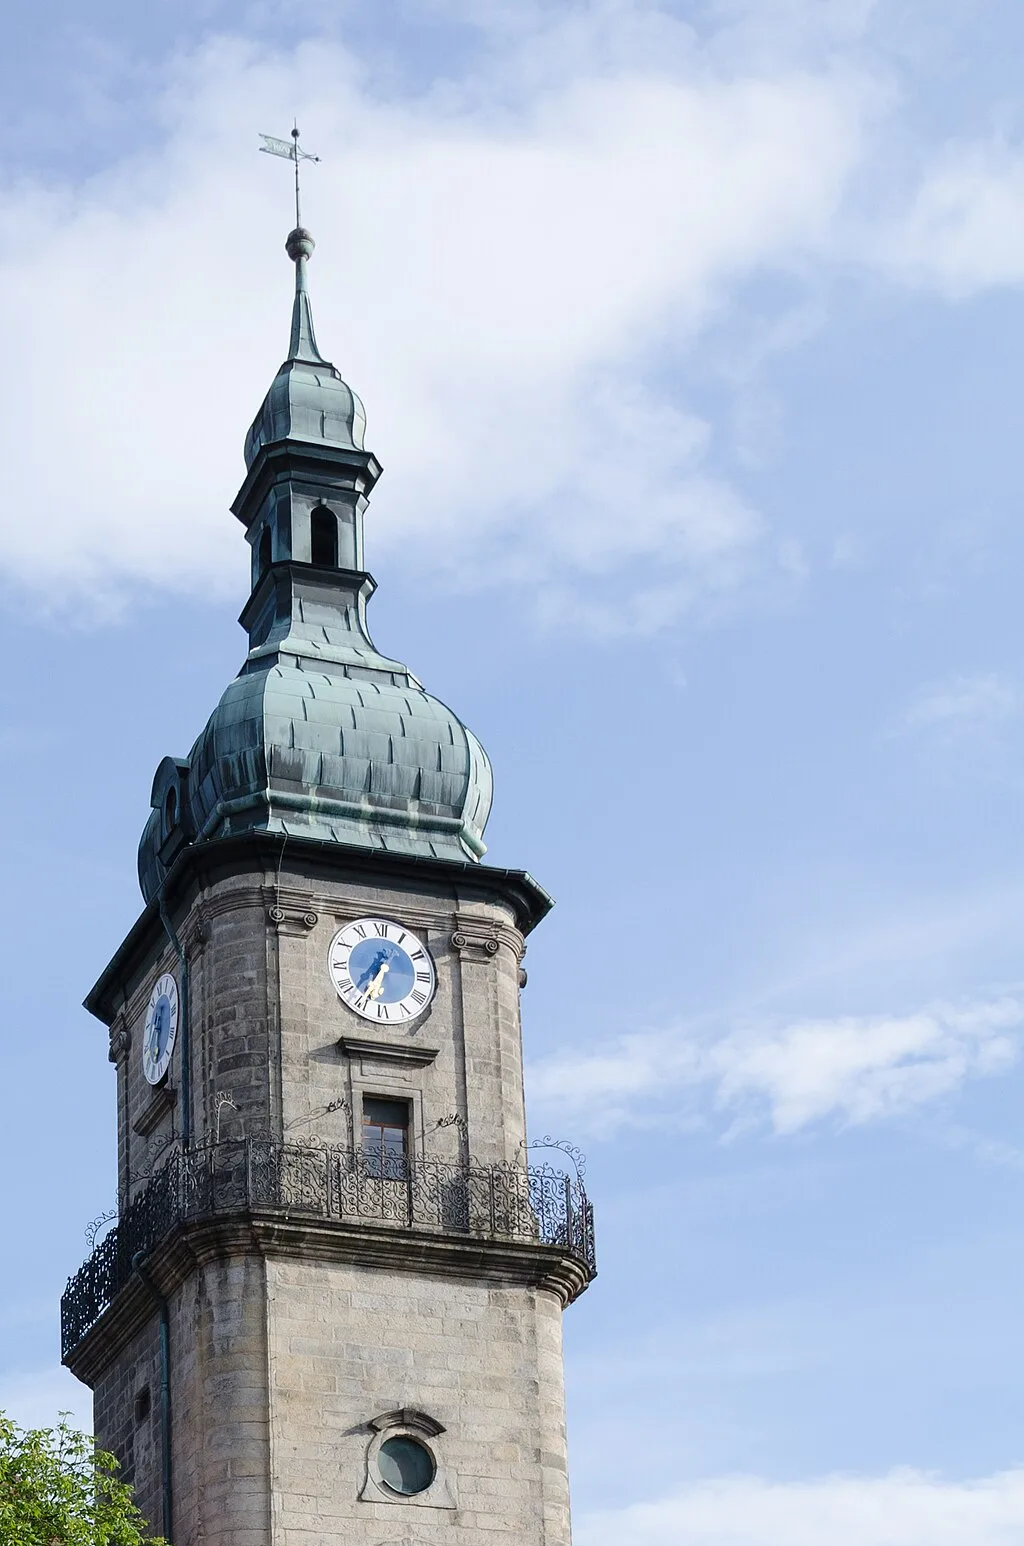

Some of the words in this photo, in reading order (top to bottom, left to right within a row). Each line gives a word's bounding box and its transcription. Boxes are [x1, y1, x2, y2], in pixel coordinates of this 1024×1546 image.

[353, 925, 367, 941] XI
[374, 923, 389, 938] XII
[337, 937, 352, 952] X
[398, 933, 406, 944] I
[411, 950, 425, 961] II
[333, 958, 347, 970] IX
[417, 972, 431, 984] III
[411, 989, 427, 1006] IIII
[377, 1004, 389, 1019] VI
[399, 1003, 411, 1017] V
